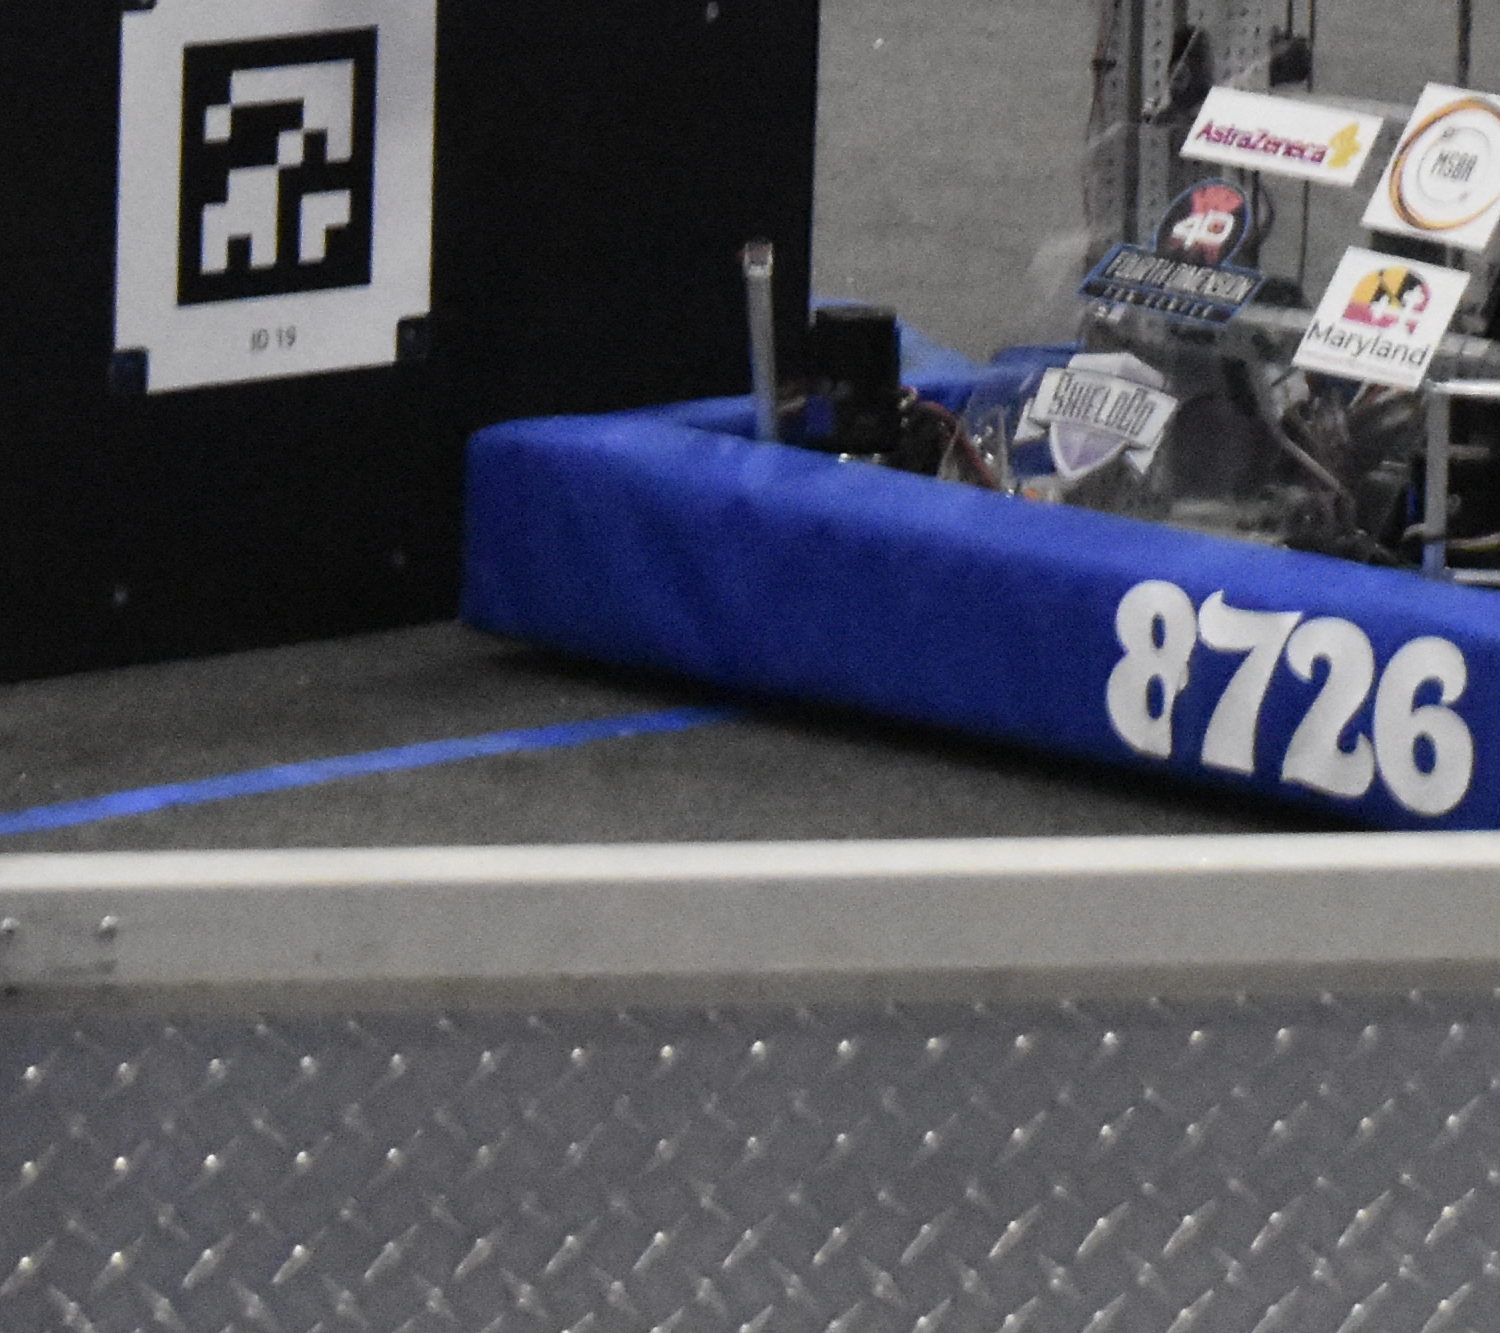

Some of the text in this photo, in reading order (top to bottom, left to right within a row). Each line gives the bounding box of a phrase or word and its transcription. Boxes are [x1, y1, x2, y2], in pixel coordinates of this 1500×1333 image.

[1195, 117, 1333, 167] AstraZeneca
[250, 325, 297, 352] ID 19
[1305, 318, 1432, 367] Maryland
[1106, 578, 1475, 818] 8726
